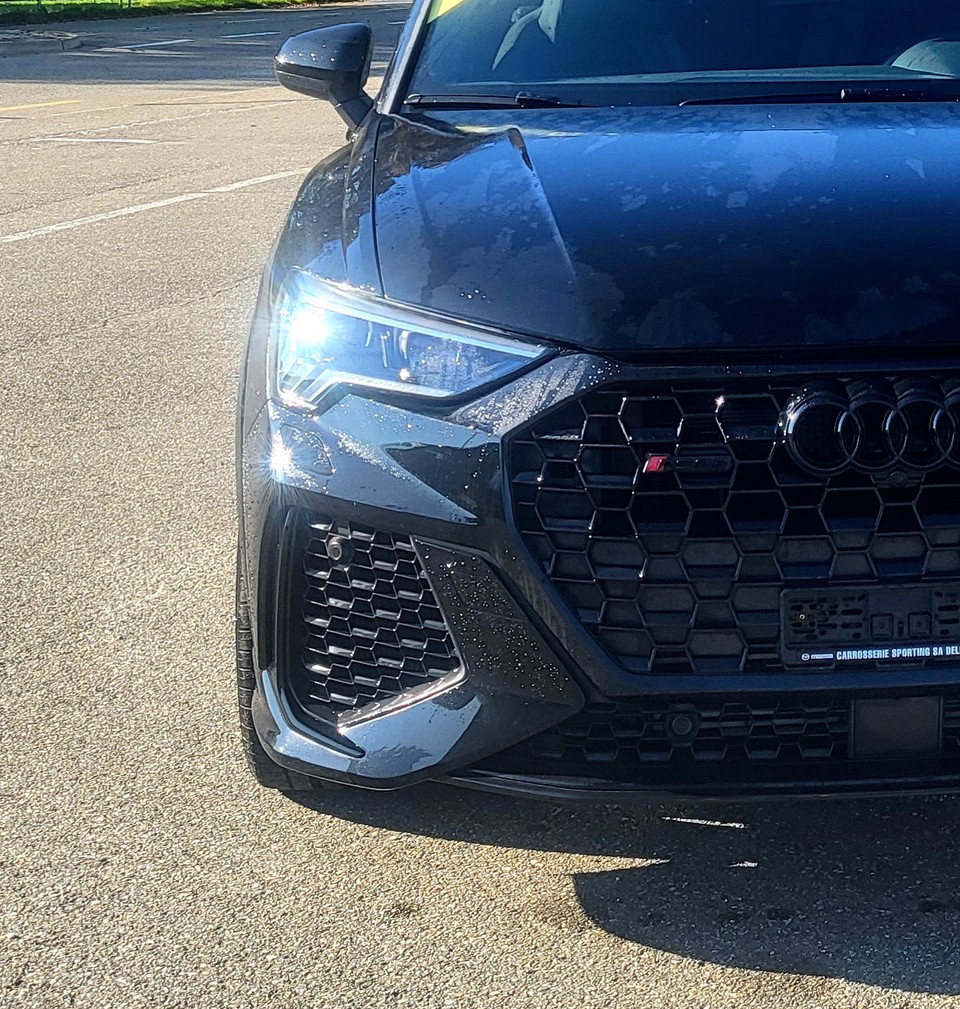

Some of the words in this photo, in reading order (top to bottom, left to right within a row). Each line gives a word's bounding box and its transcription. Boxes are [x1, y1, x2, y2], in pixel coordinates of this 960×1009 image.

[836, 649, 889, 661] CARROSSERIE
[891, 647, 930, 659] SPORTING
[932, 646, 944, 657] SA
